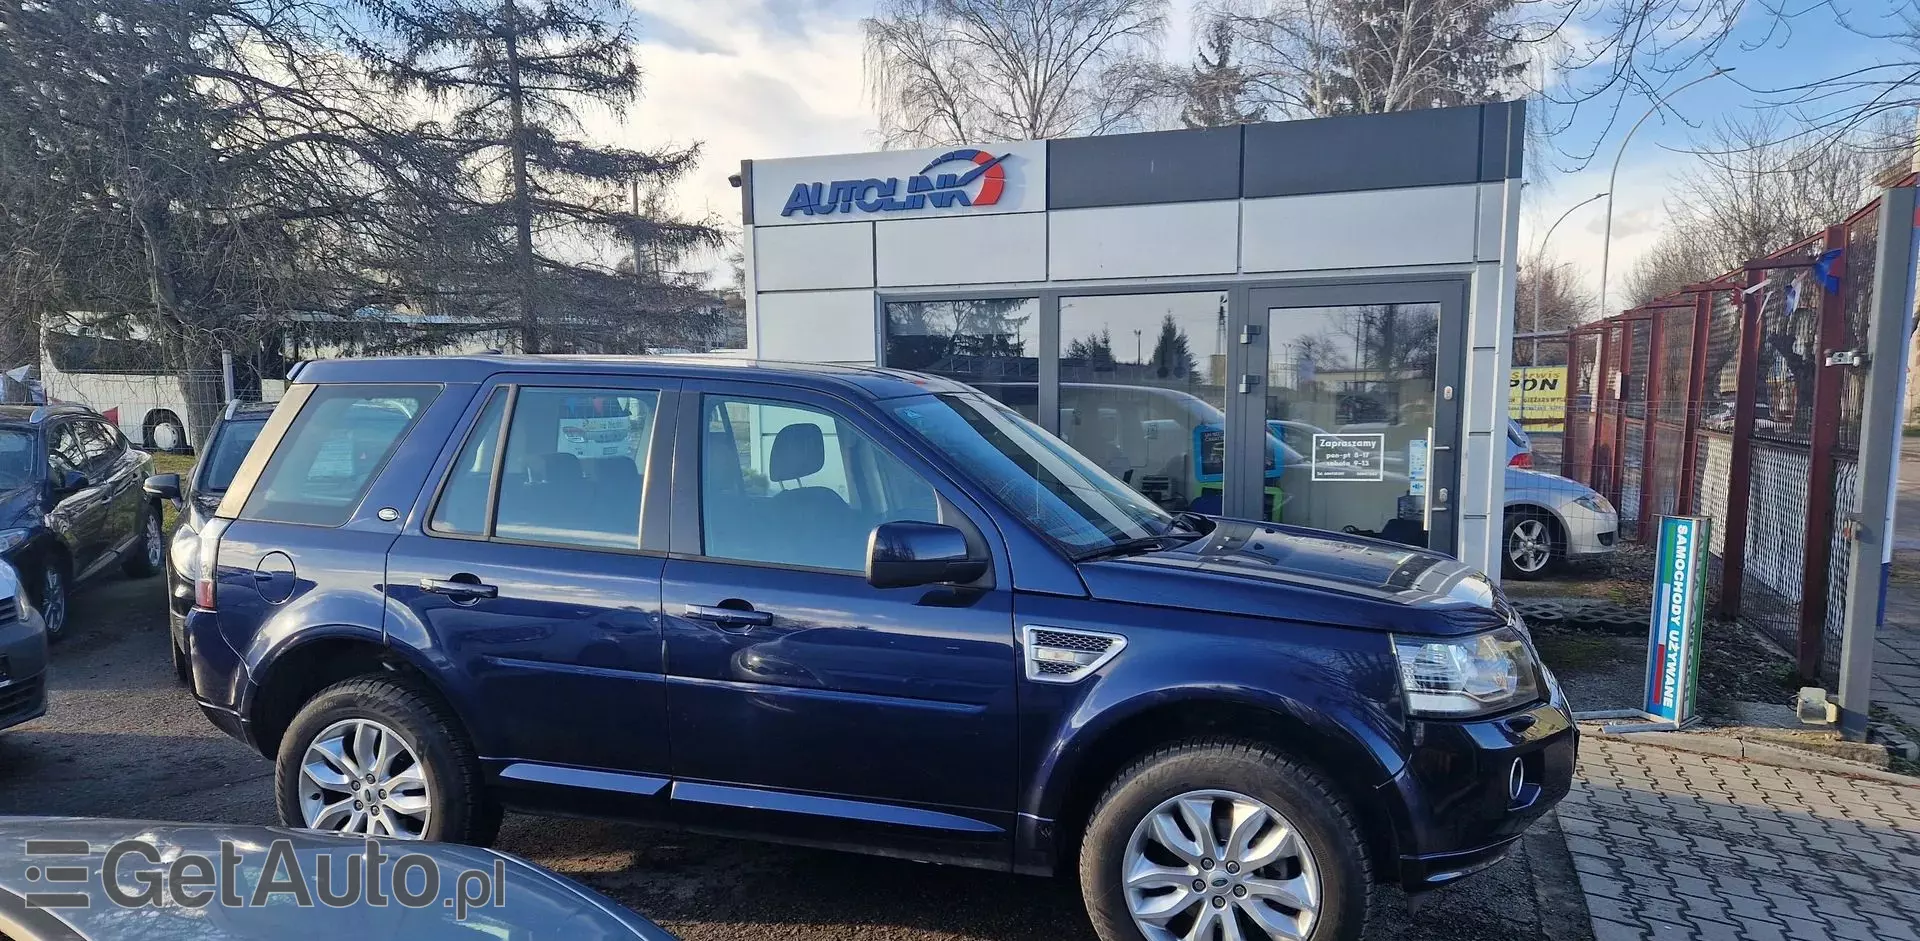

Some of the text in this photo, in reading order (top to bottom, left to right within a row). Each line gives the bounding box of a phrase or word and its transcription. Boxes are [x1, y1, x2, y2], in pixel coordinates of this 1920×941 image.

[780, 173, 973, 216] AUTOLINK
[1320, 439, 1376, 448] Zapraszamy
[1663, 524, 1688, 708] SAMOCHODY UŻYWANE
